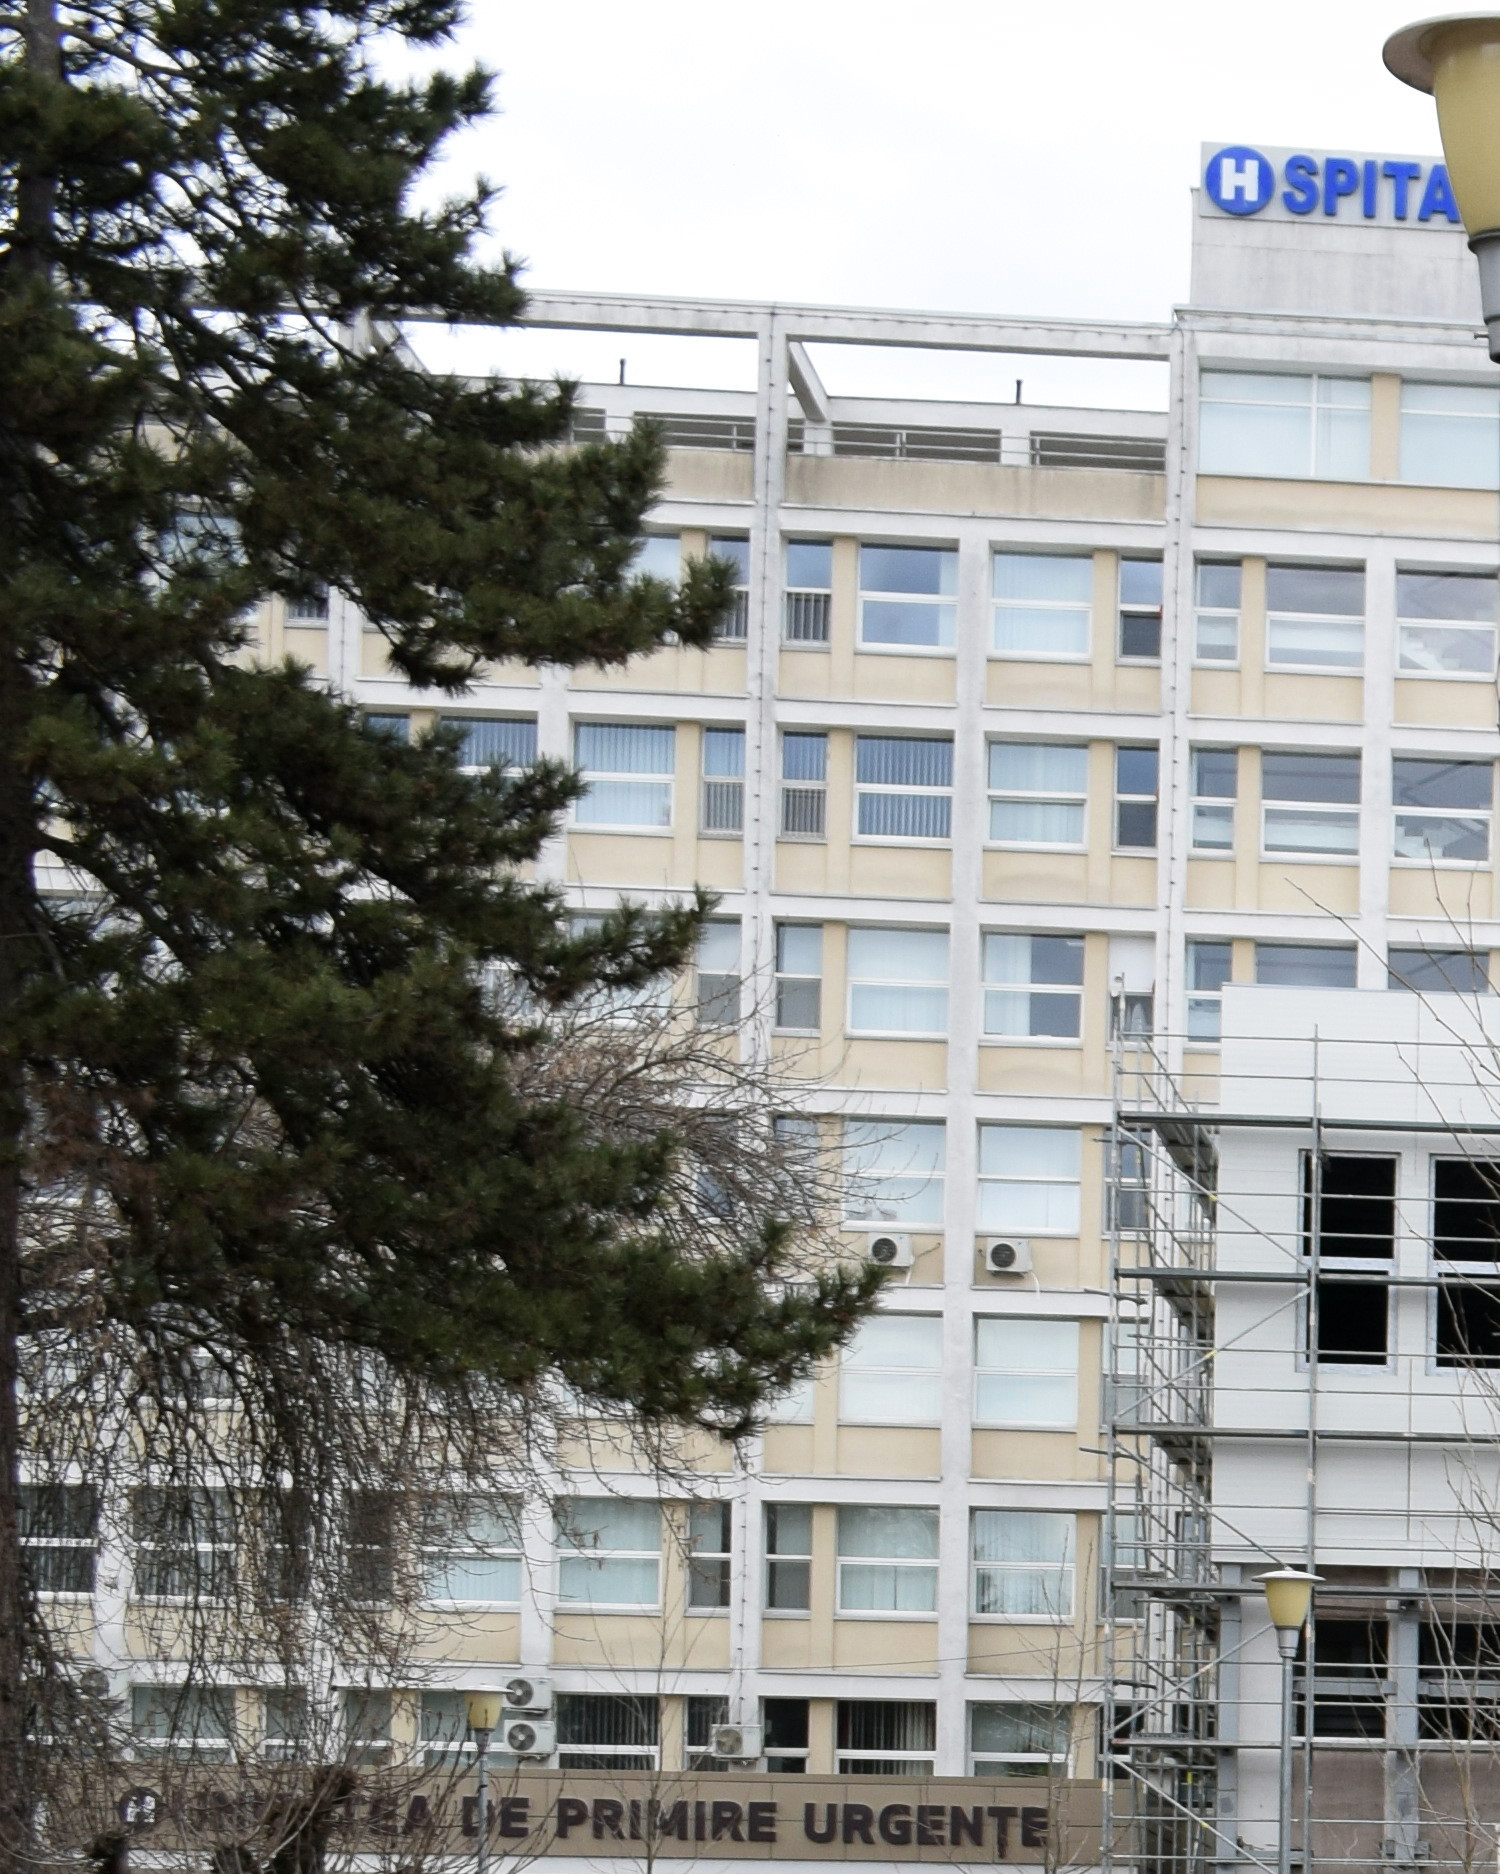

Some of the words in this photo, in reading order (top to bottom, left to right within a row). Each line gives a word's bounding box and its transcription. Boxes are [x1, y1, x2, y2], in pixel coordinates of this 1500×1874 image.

[1282, 154, 1462, 223] SPITA
[462, 1796, 529, 1838] DE
[557, 1797, 777, 1842] PRIMIRE
